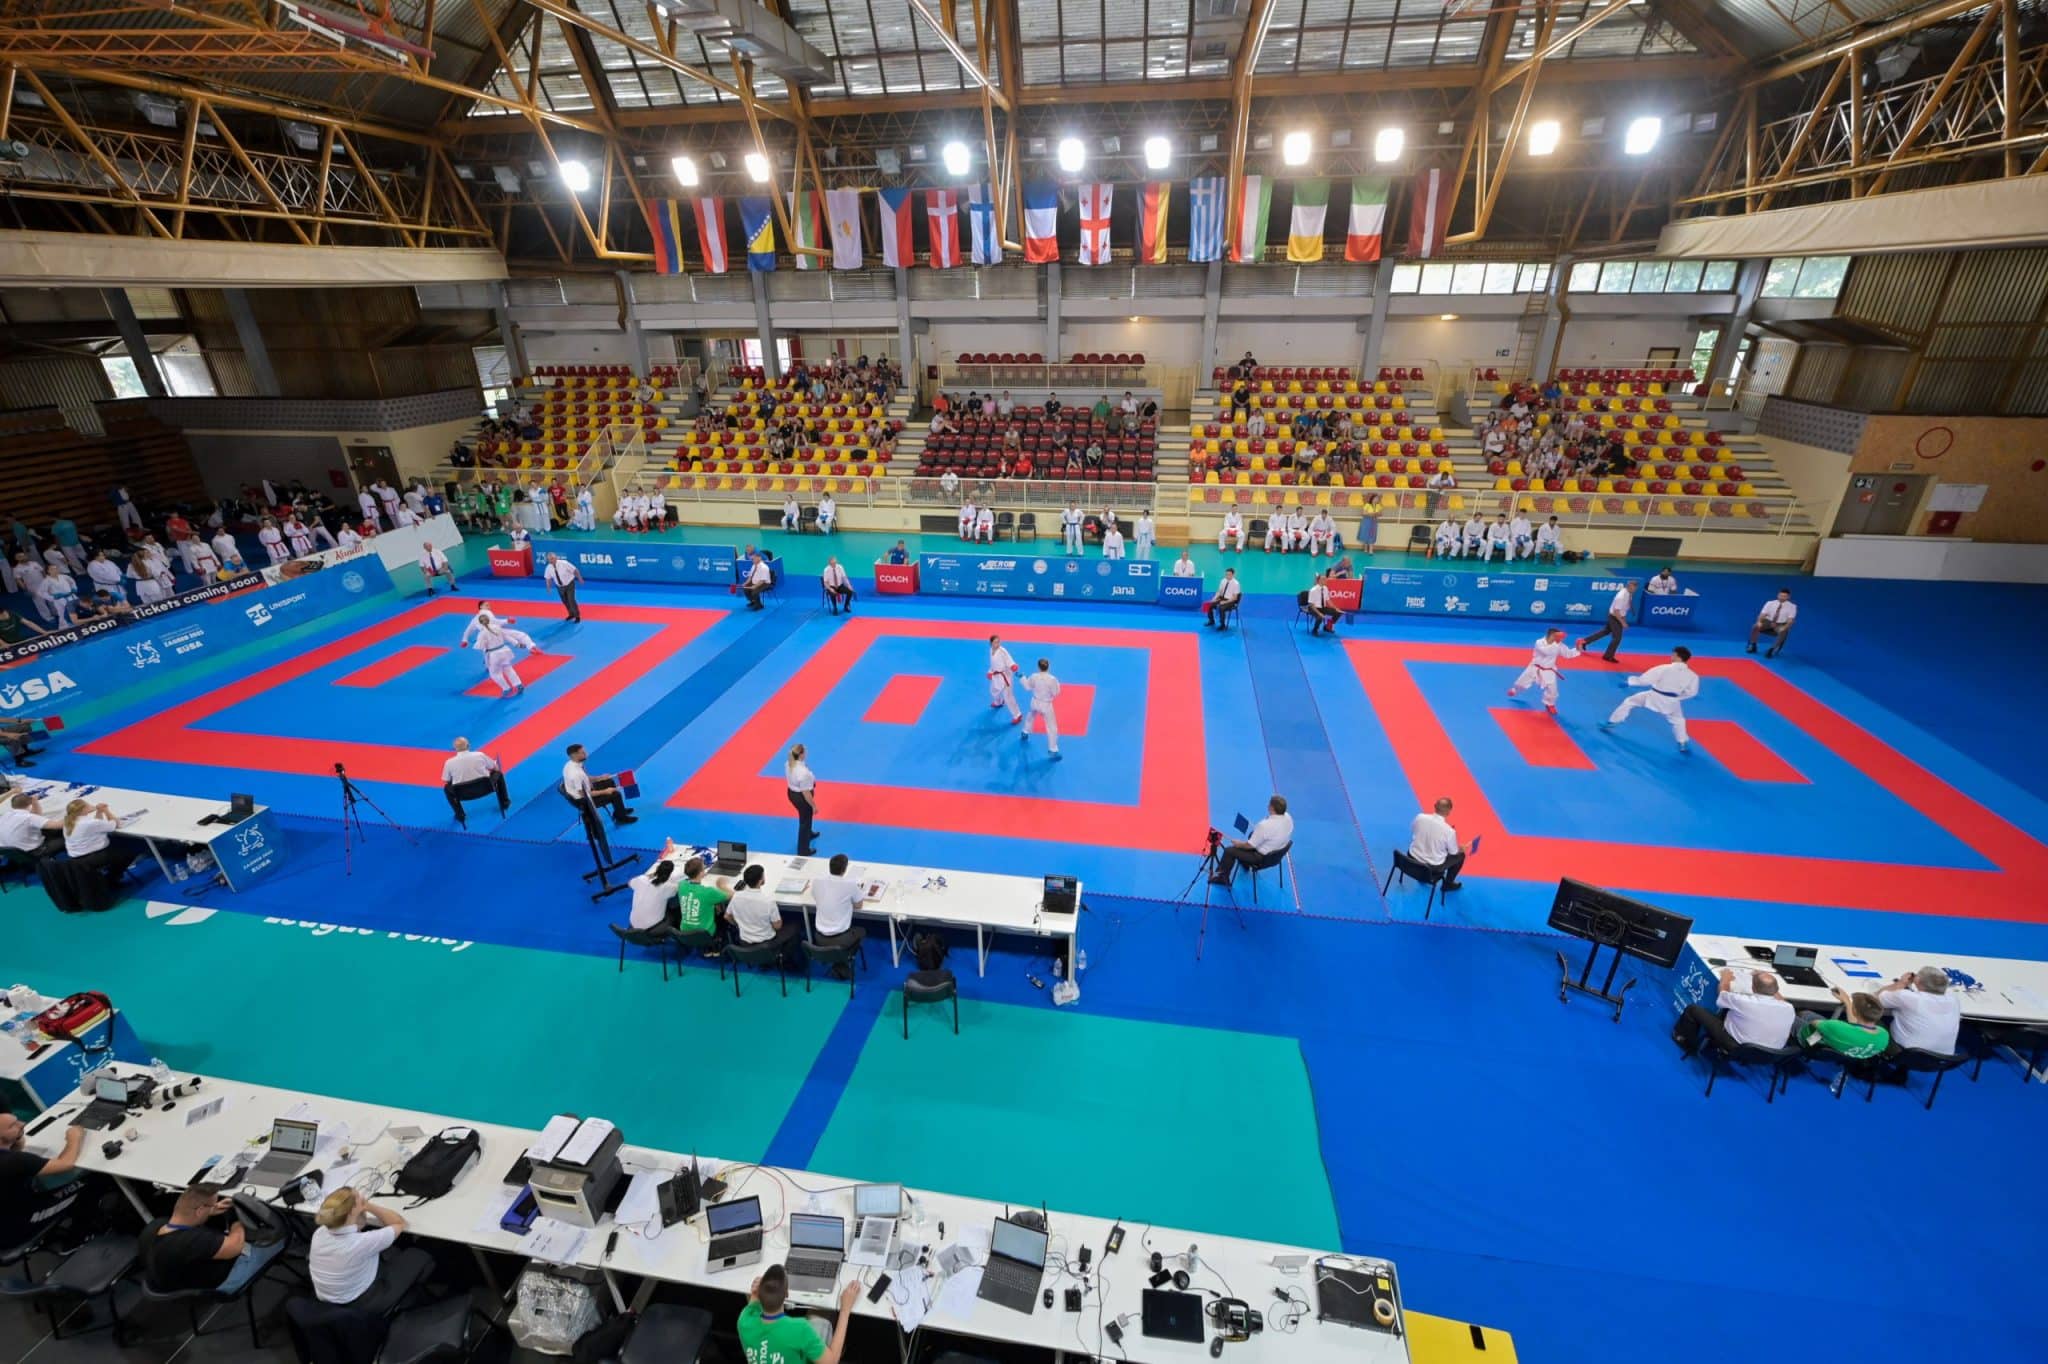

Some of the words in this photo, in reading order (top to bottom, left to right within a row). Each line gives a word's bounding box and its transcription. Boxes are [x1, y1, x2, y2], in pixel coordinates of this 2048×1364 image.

[580, 553, 613, 564] EUSA
[879, 574, 909, 584] COACH
[1592, 581, 1625, 591] EUSA
[1165, 587, 1197, 596] COACH
[1329, 590, 1356, 599] OACH
[132, 599, 181, 620] Tickets
[183, 584, 229, 604] coming
[231, 576, 259, 590] soon
[1652, 606, 1690, 615] COACH
[18, 630, 79, 656] coming
[81, 618, 118, 637] soon
